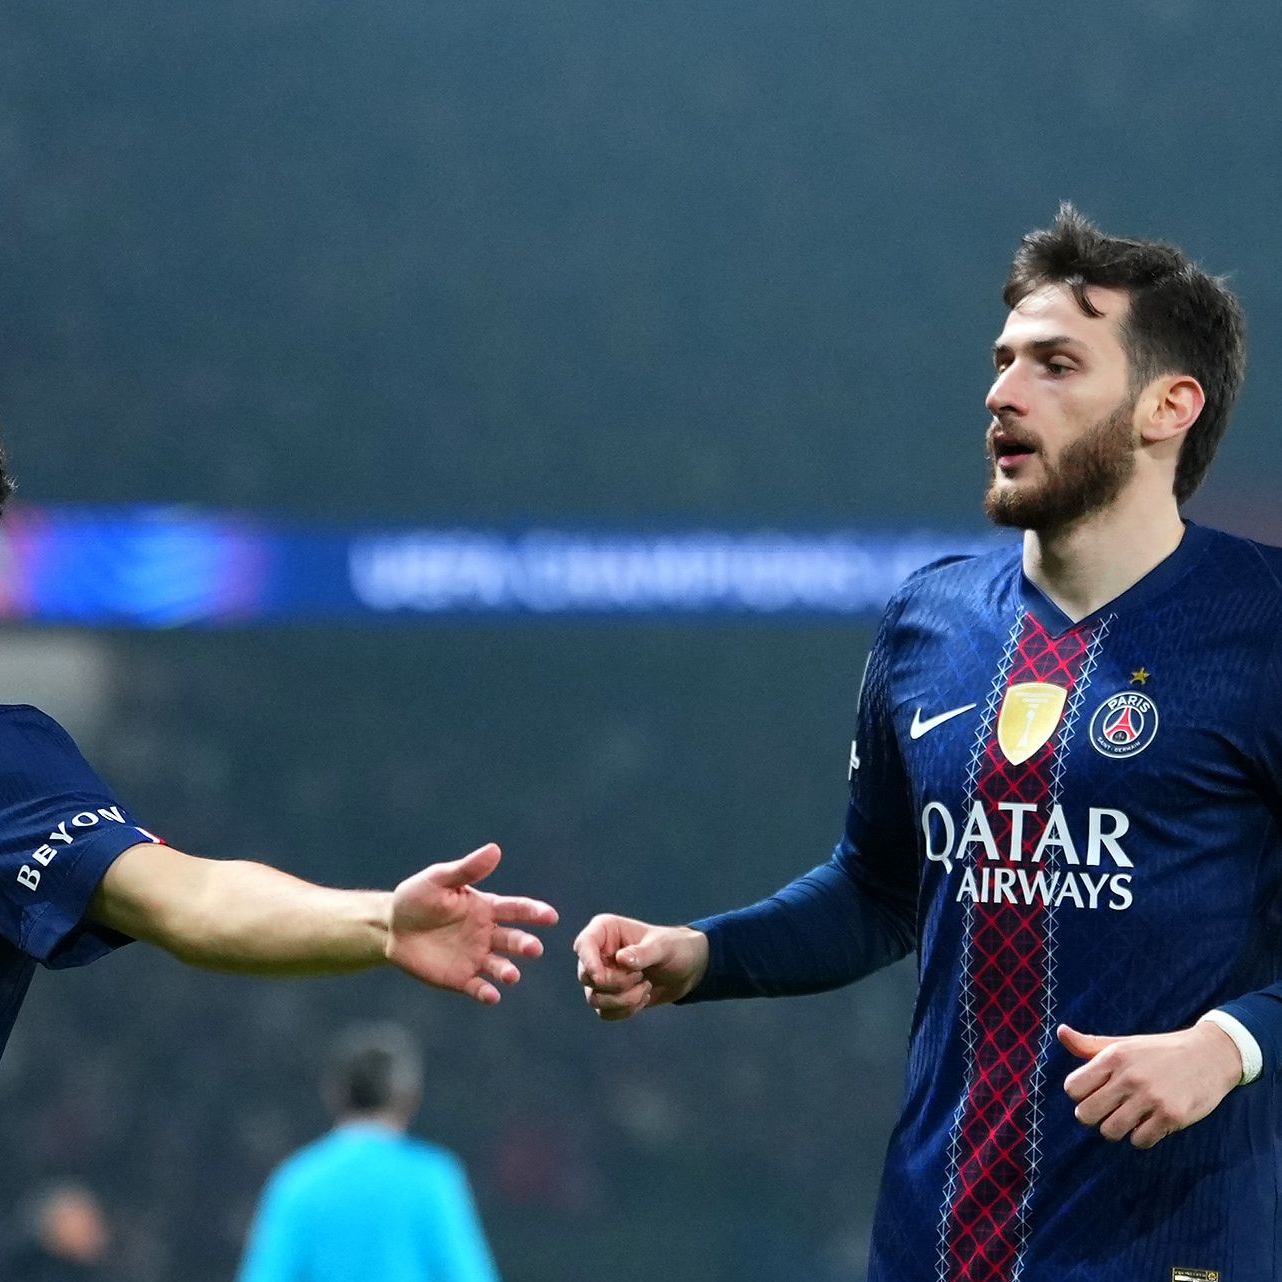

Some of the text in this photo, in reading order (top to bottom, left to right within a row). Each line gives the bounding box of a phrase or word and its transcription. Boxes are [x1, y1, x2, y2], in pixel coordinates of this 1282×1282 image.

[1108, 695, 1150, 713] PARIS
[17, 806, 126, 891] BEYON
[921, 801, 1134, 874] QATAR
[956, 866, 1133, 910] AIRWAYS
